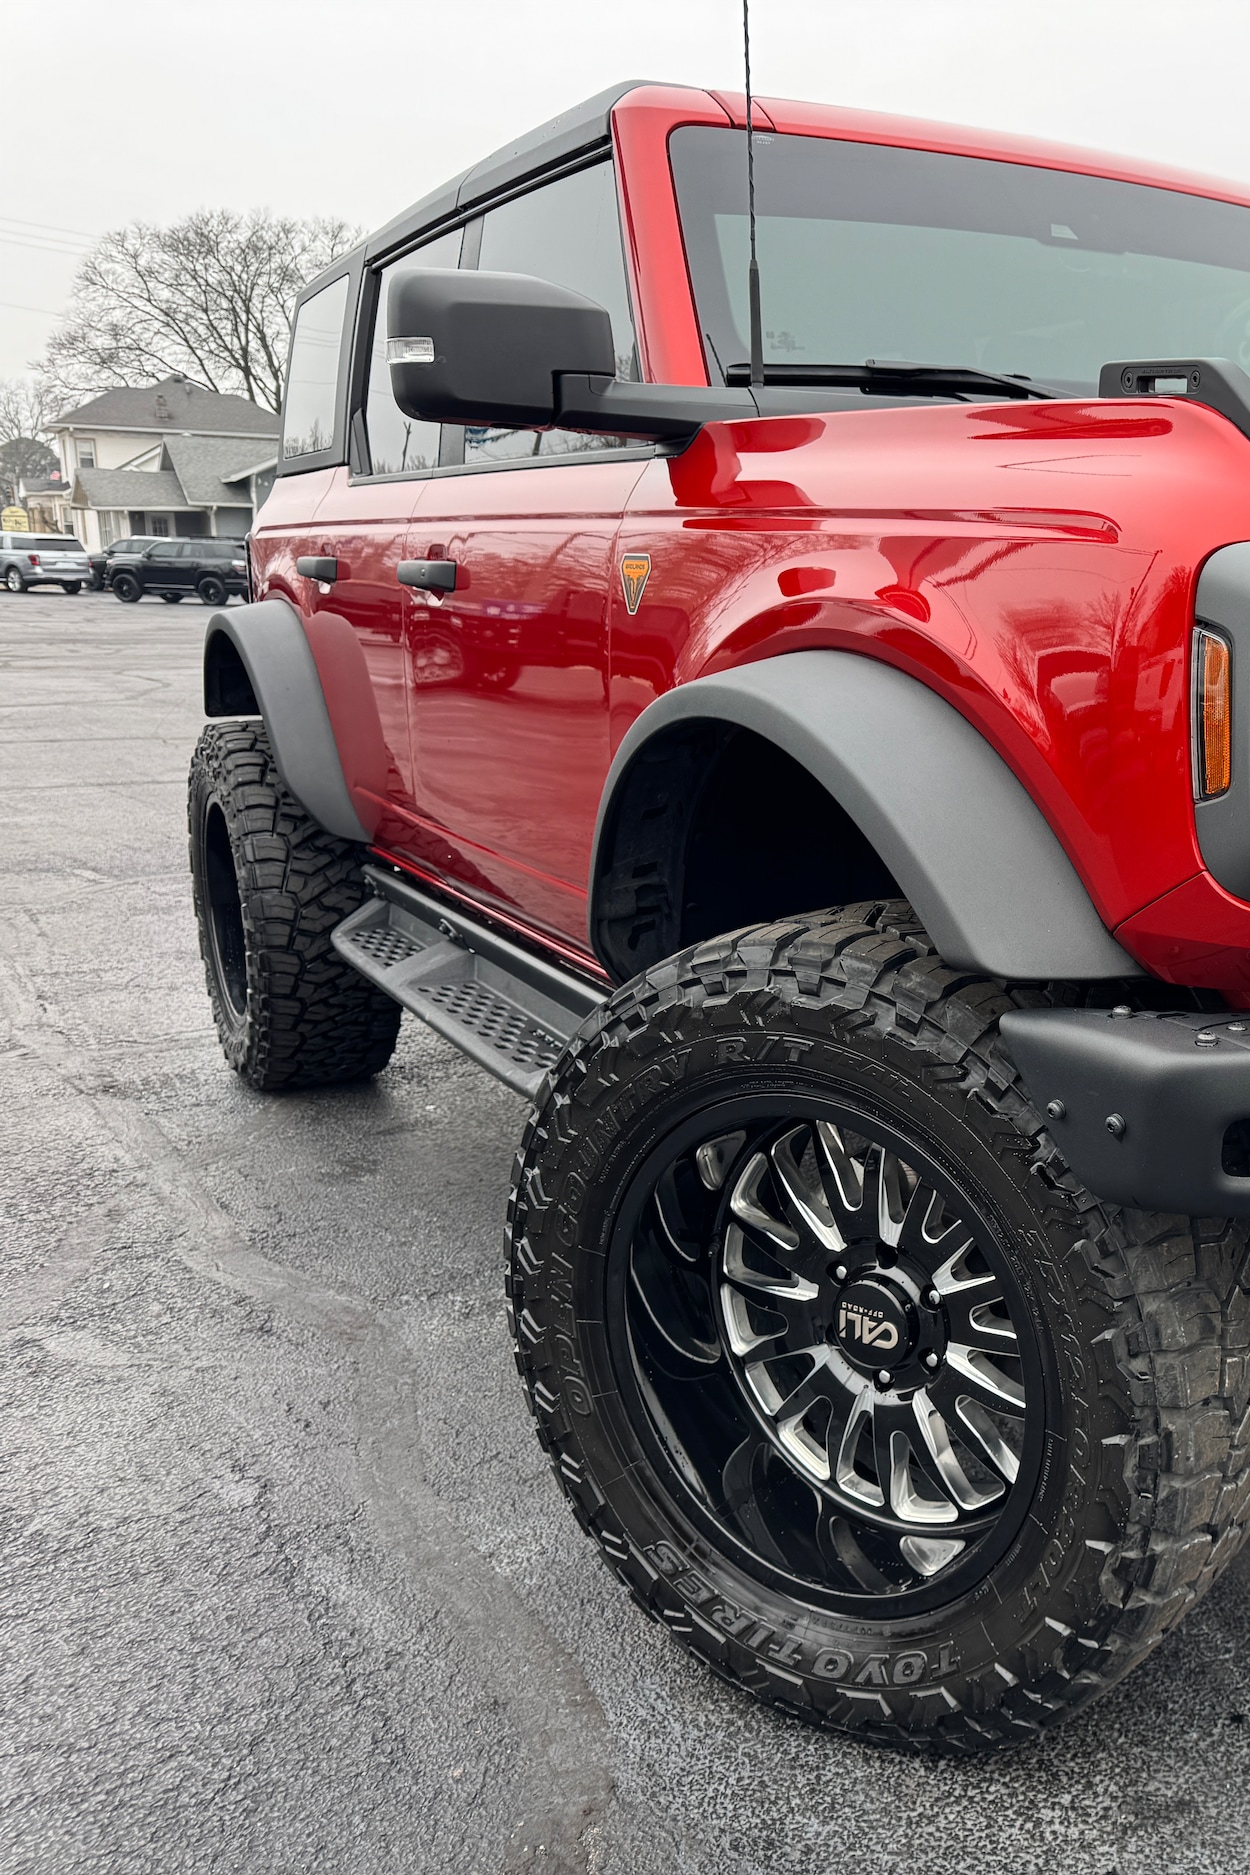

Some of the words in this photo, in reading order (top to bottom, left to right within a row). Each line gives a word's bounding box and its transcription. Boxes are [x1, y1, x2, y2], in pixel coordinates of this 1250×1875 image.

[714, 1035, 815, 1065] R/T
[839, 1308, 899, 1350] CALI
[642, 1540, 804, 1668] TIRES
[810, 1639, 961, 1686] TOYO
